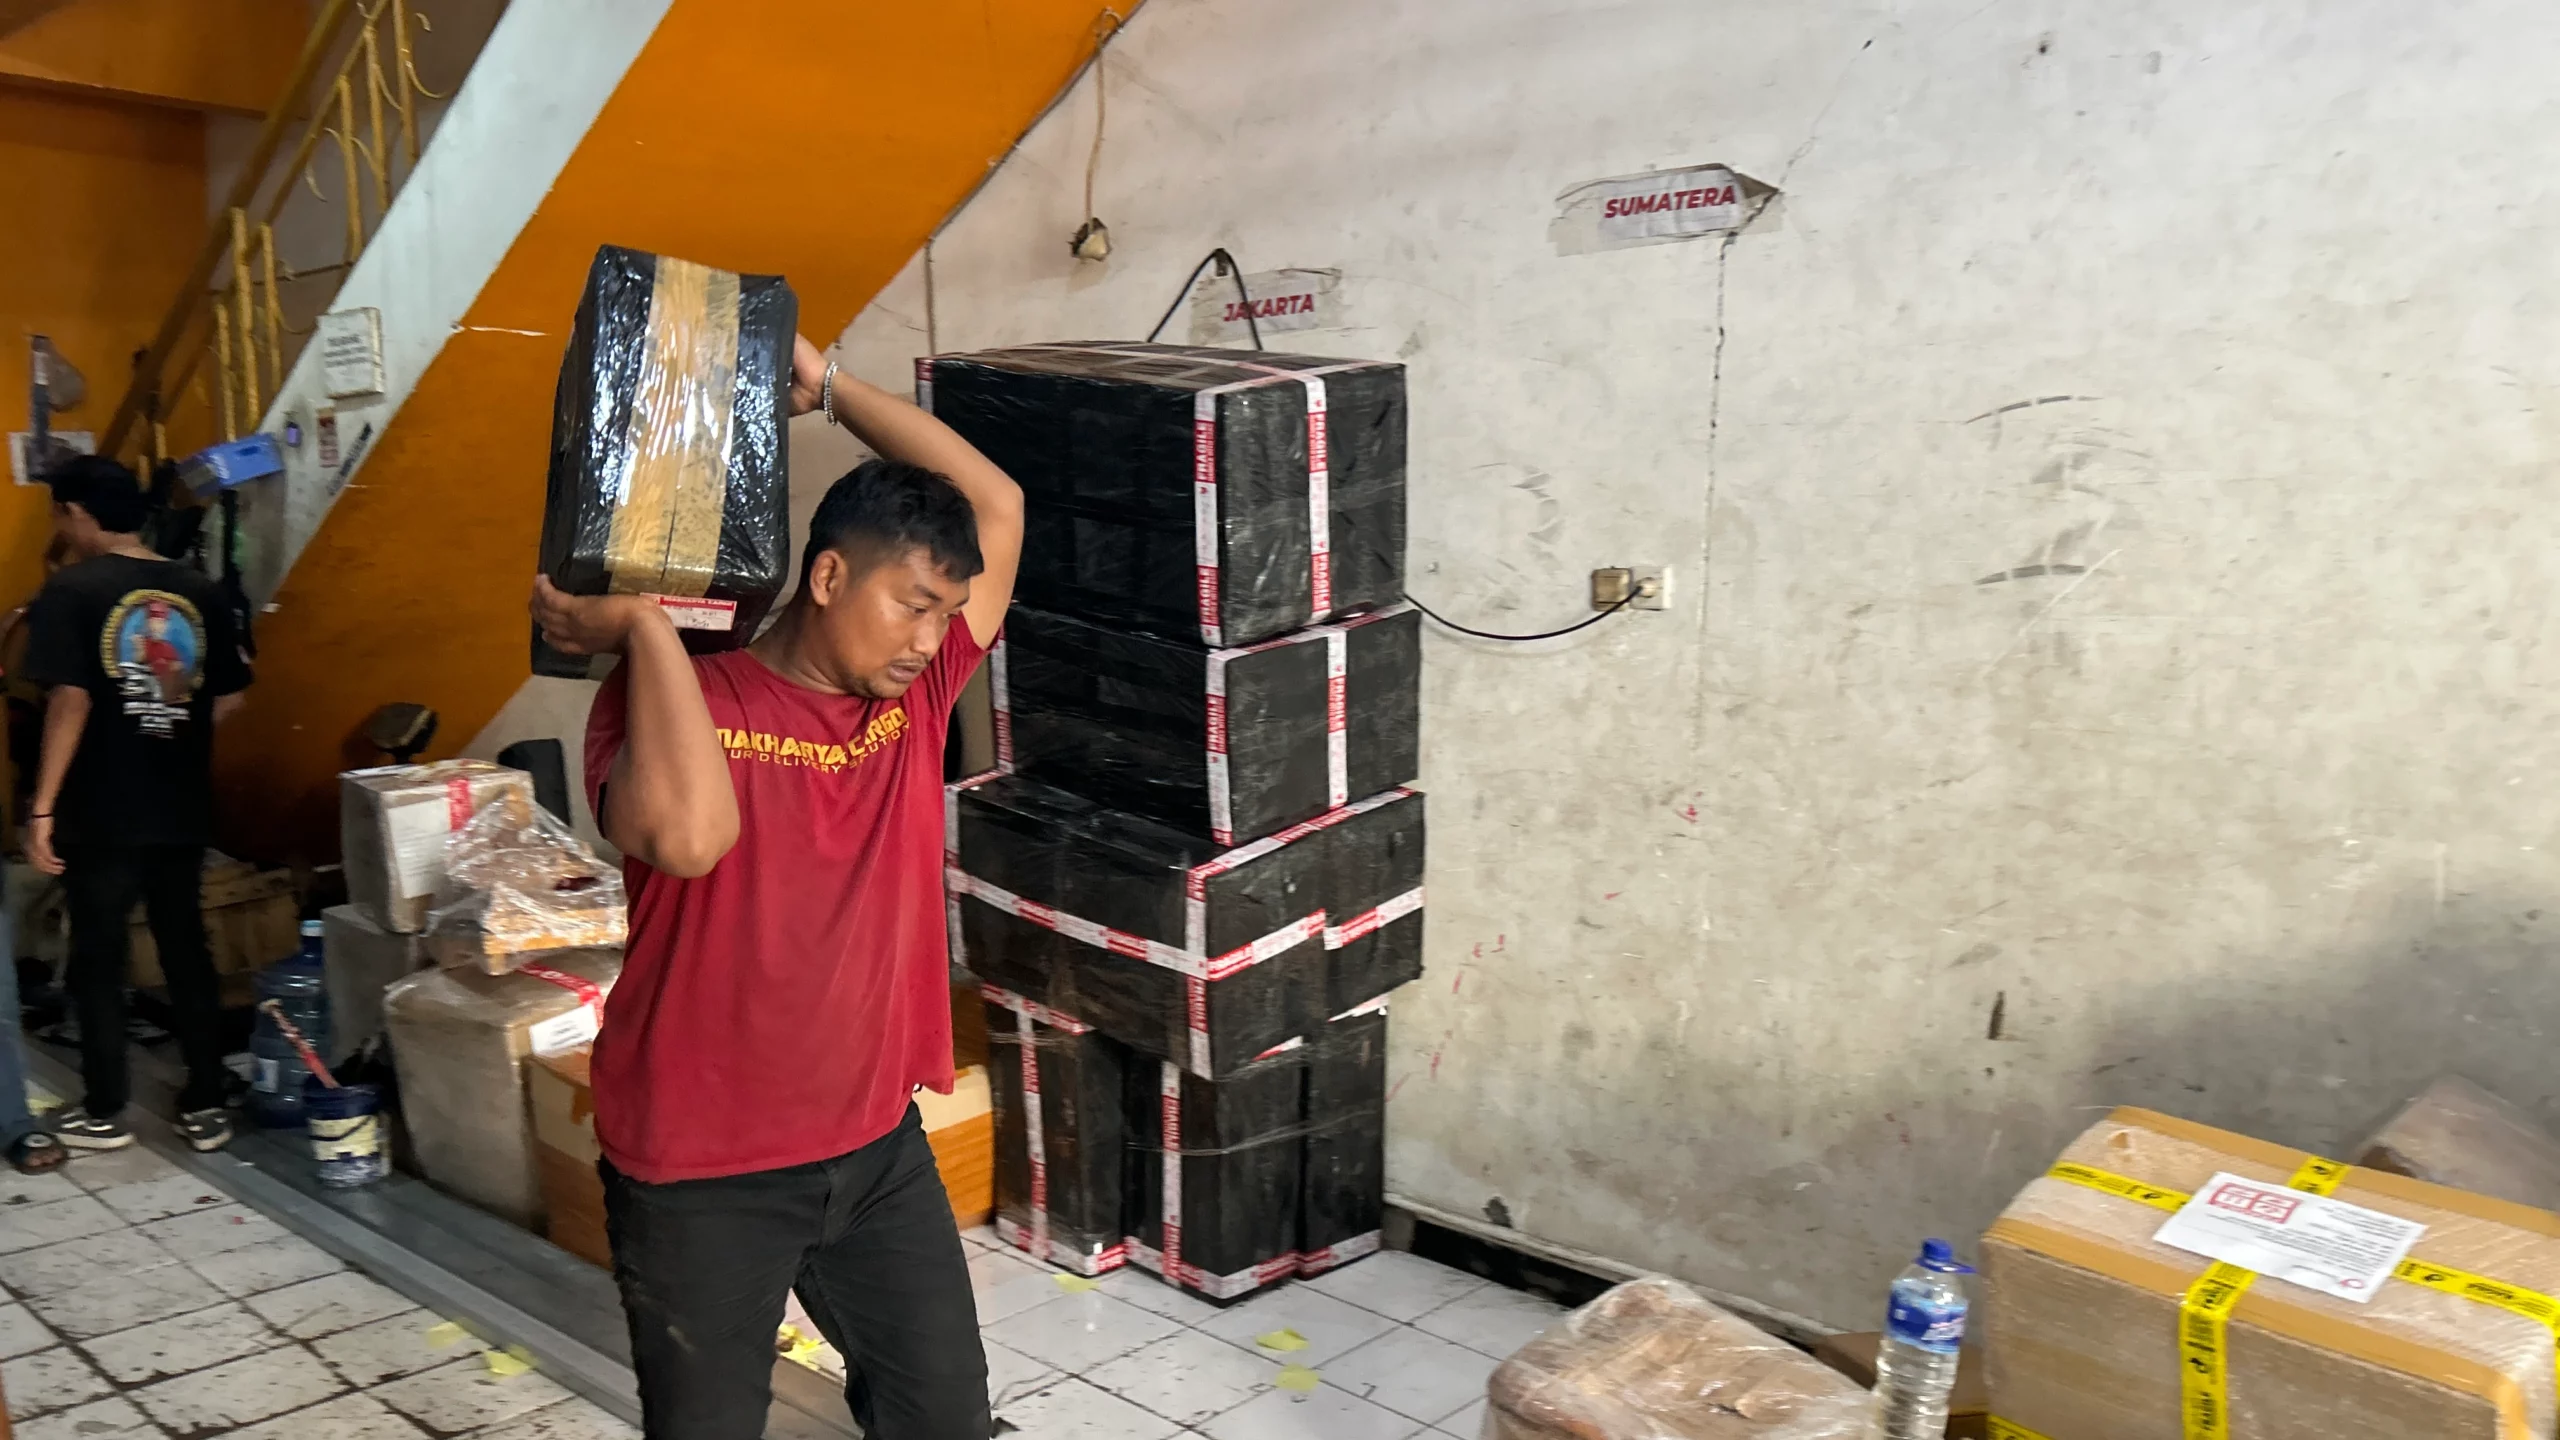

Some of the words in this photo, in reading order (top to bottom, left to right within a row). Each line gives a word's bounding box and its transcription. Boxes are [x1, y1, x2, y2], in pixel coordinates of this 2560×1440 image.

[1604, 185, 1737, 218] SUMATERA
[1223, 293, 1315, 322] JAKARTA
[1196, 421, 1207, 482] FRAGILE
[1315, 413, 1327, 470] FRAGILE
[1199, 567, 1211, 624] FRAGILE
[1318, 553, 1330, 610] FRAGILE
[730, 749, 753, 760] UR
[758, 752, 842, 775] DELIVERY
[848, 721, 911, 770] SUTIO
[1207, 695, 1218, 751] FRAGILE
